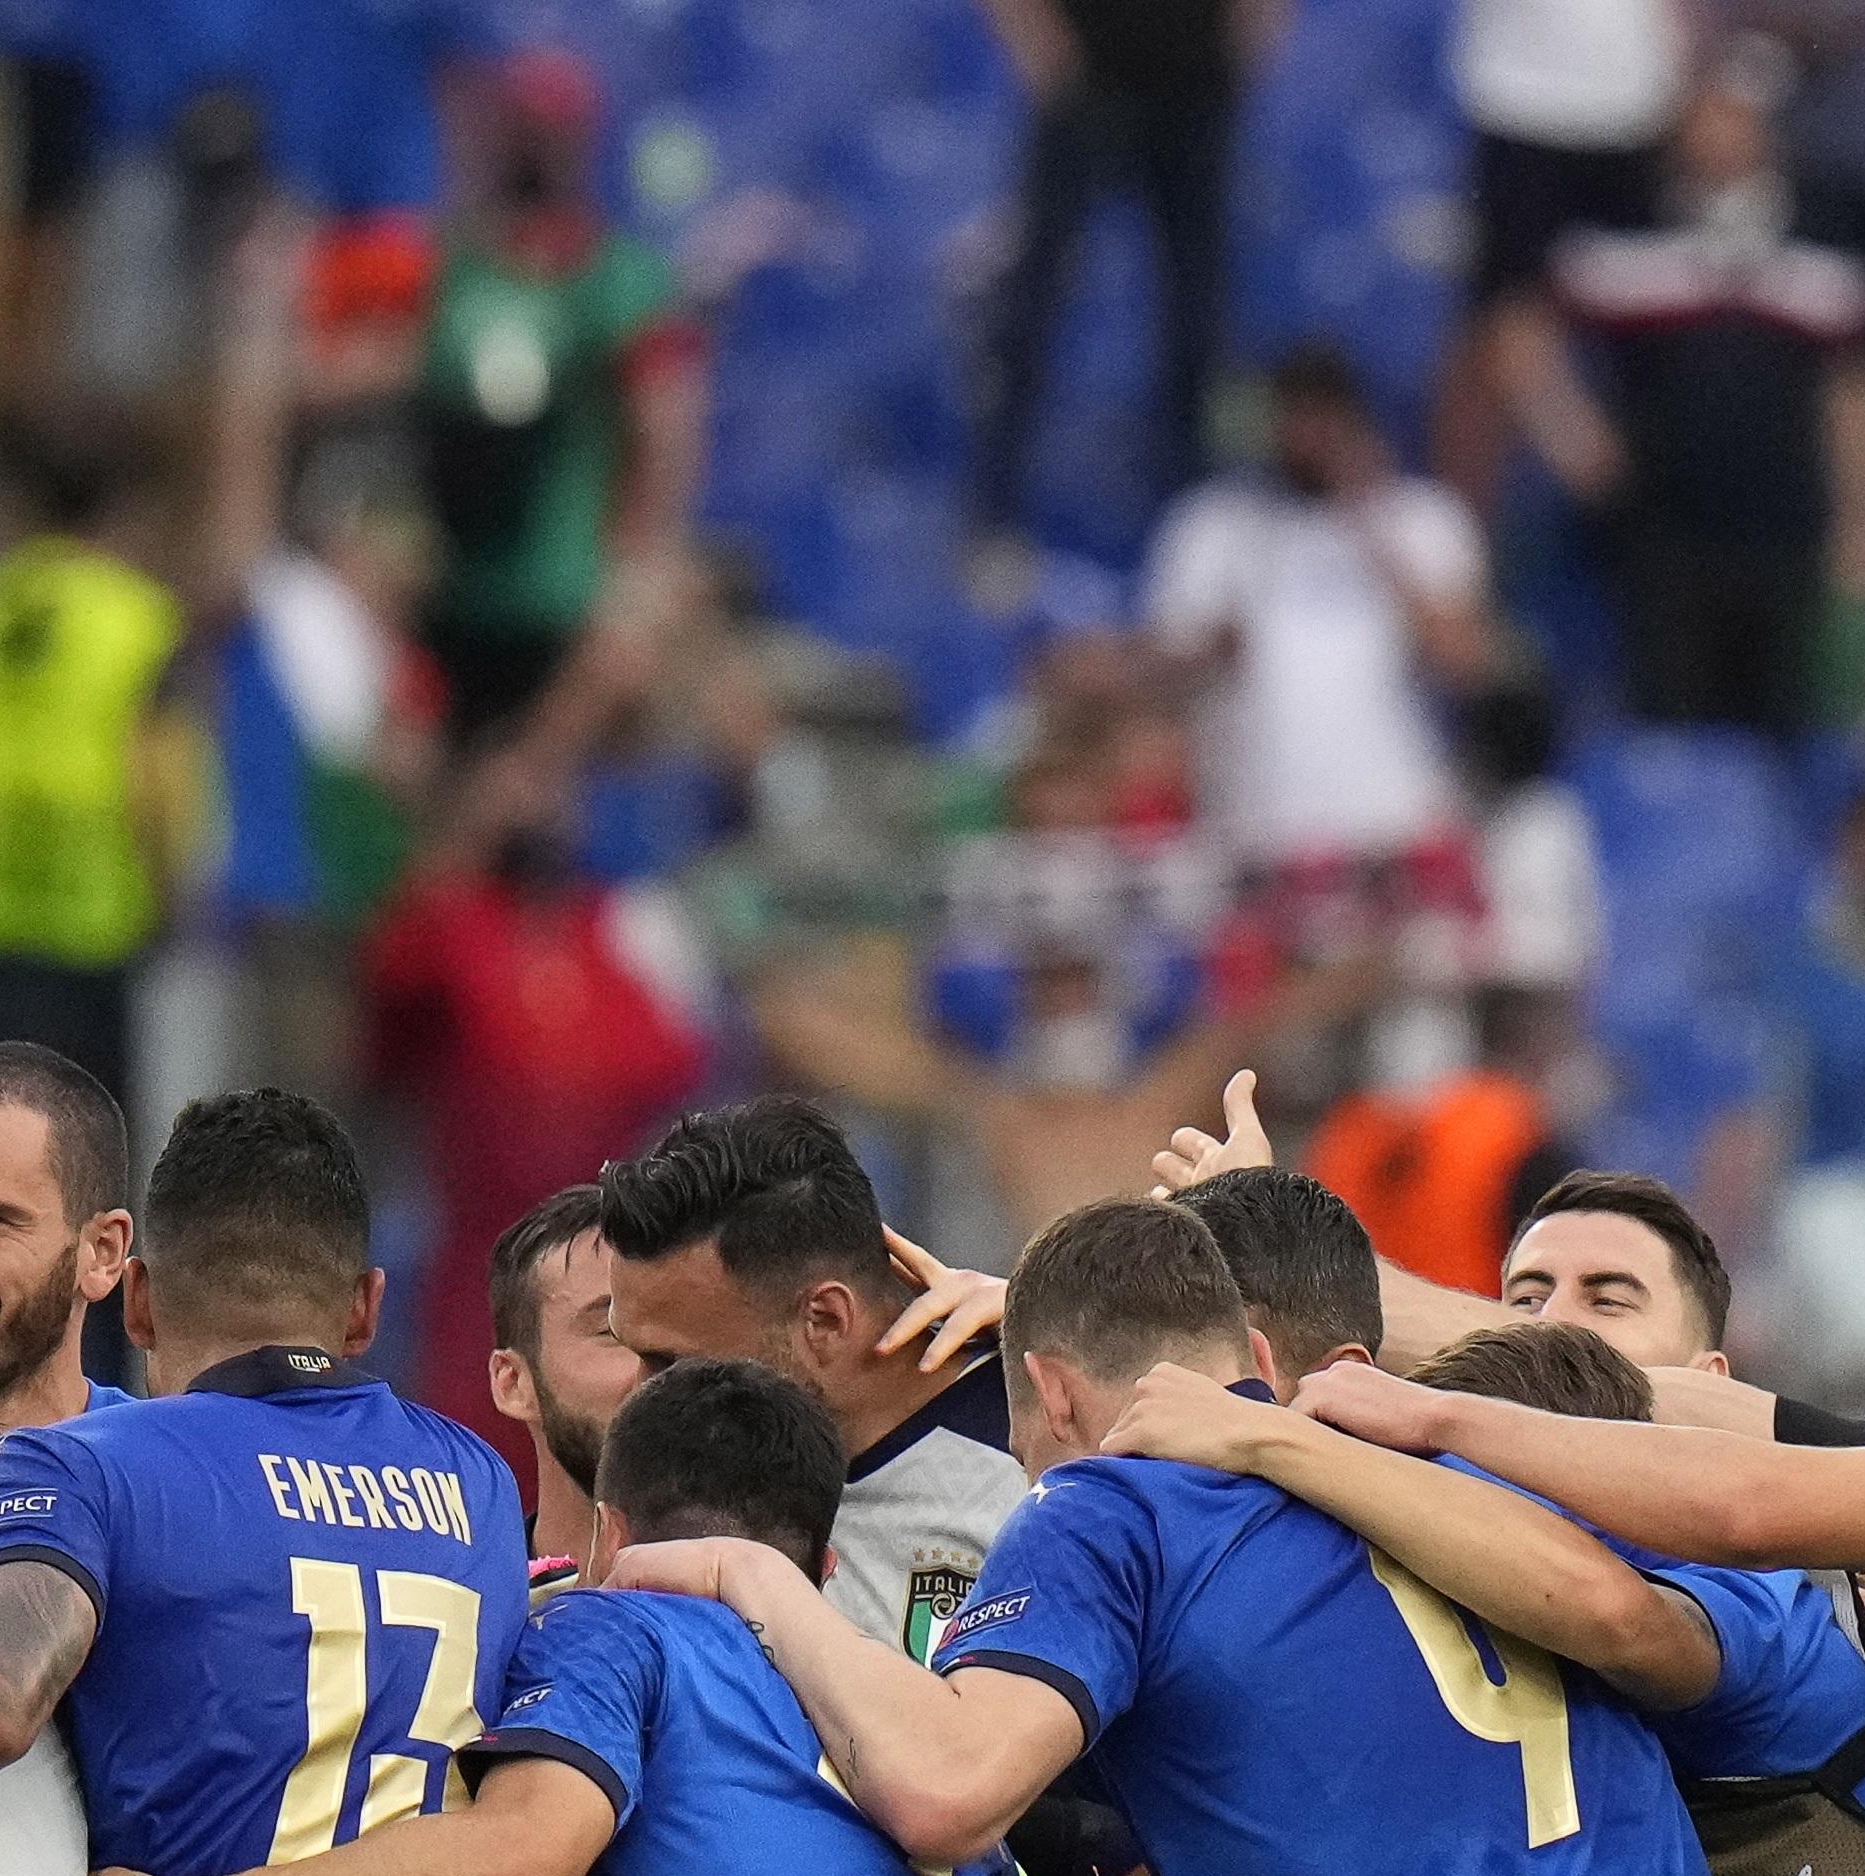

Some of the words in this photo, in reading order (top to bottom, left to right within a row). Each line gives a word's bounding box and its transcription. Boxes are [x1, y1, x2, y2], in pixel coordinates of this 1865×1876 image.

[288, 1353, 332, 1370] ITALIA
[257, 1454, 471, 1545] EMERSON
[958, 1596, 1031, 1633] RESPECT
[267, 1556, 484, 1867] 13
